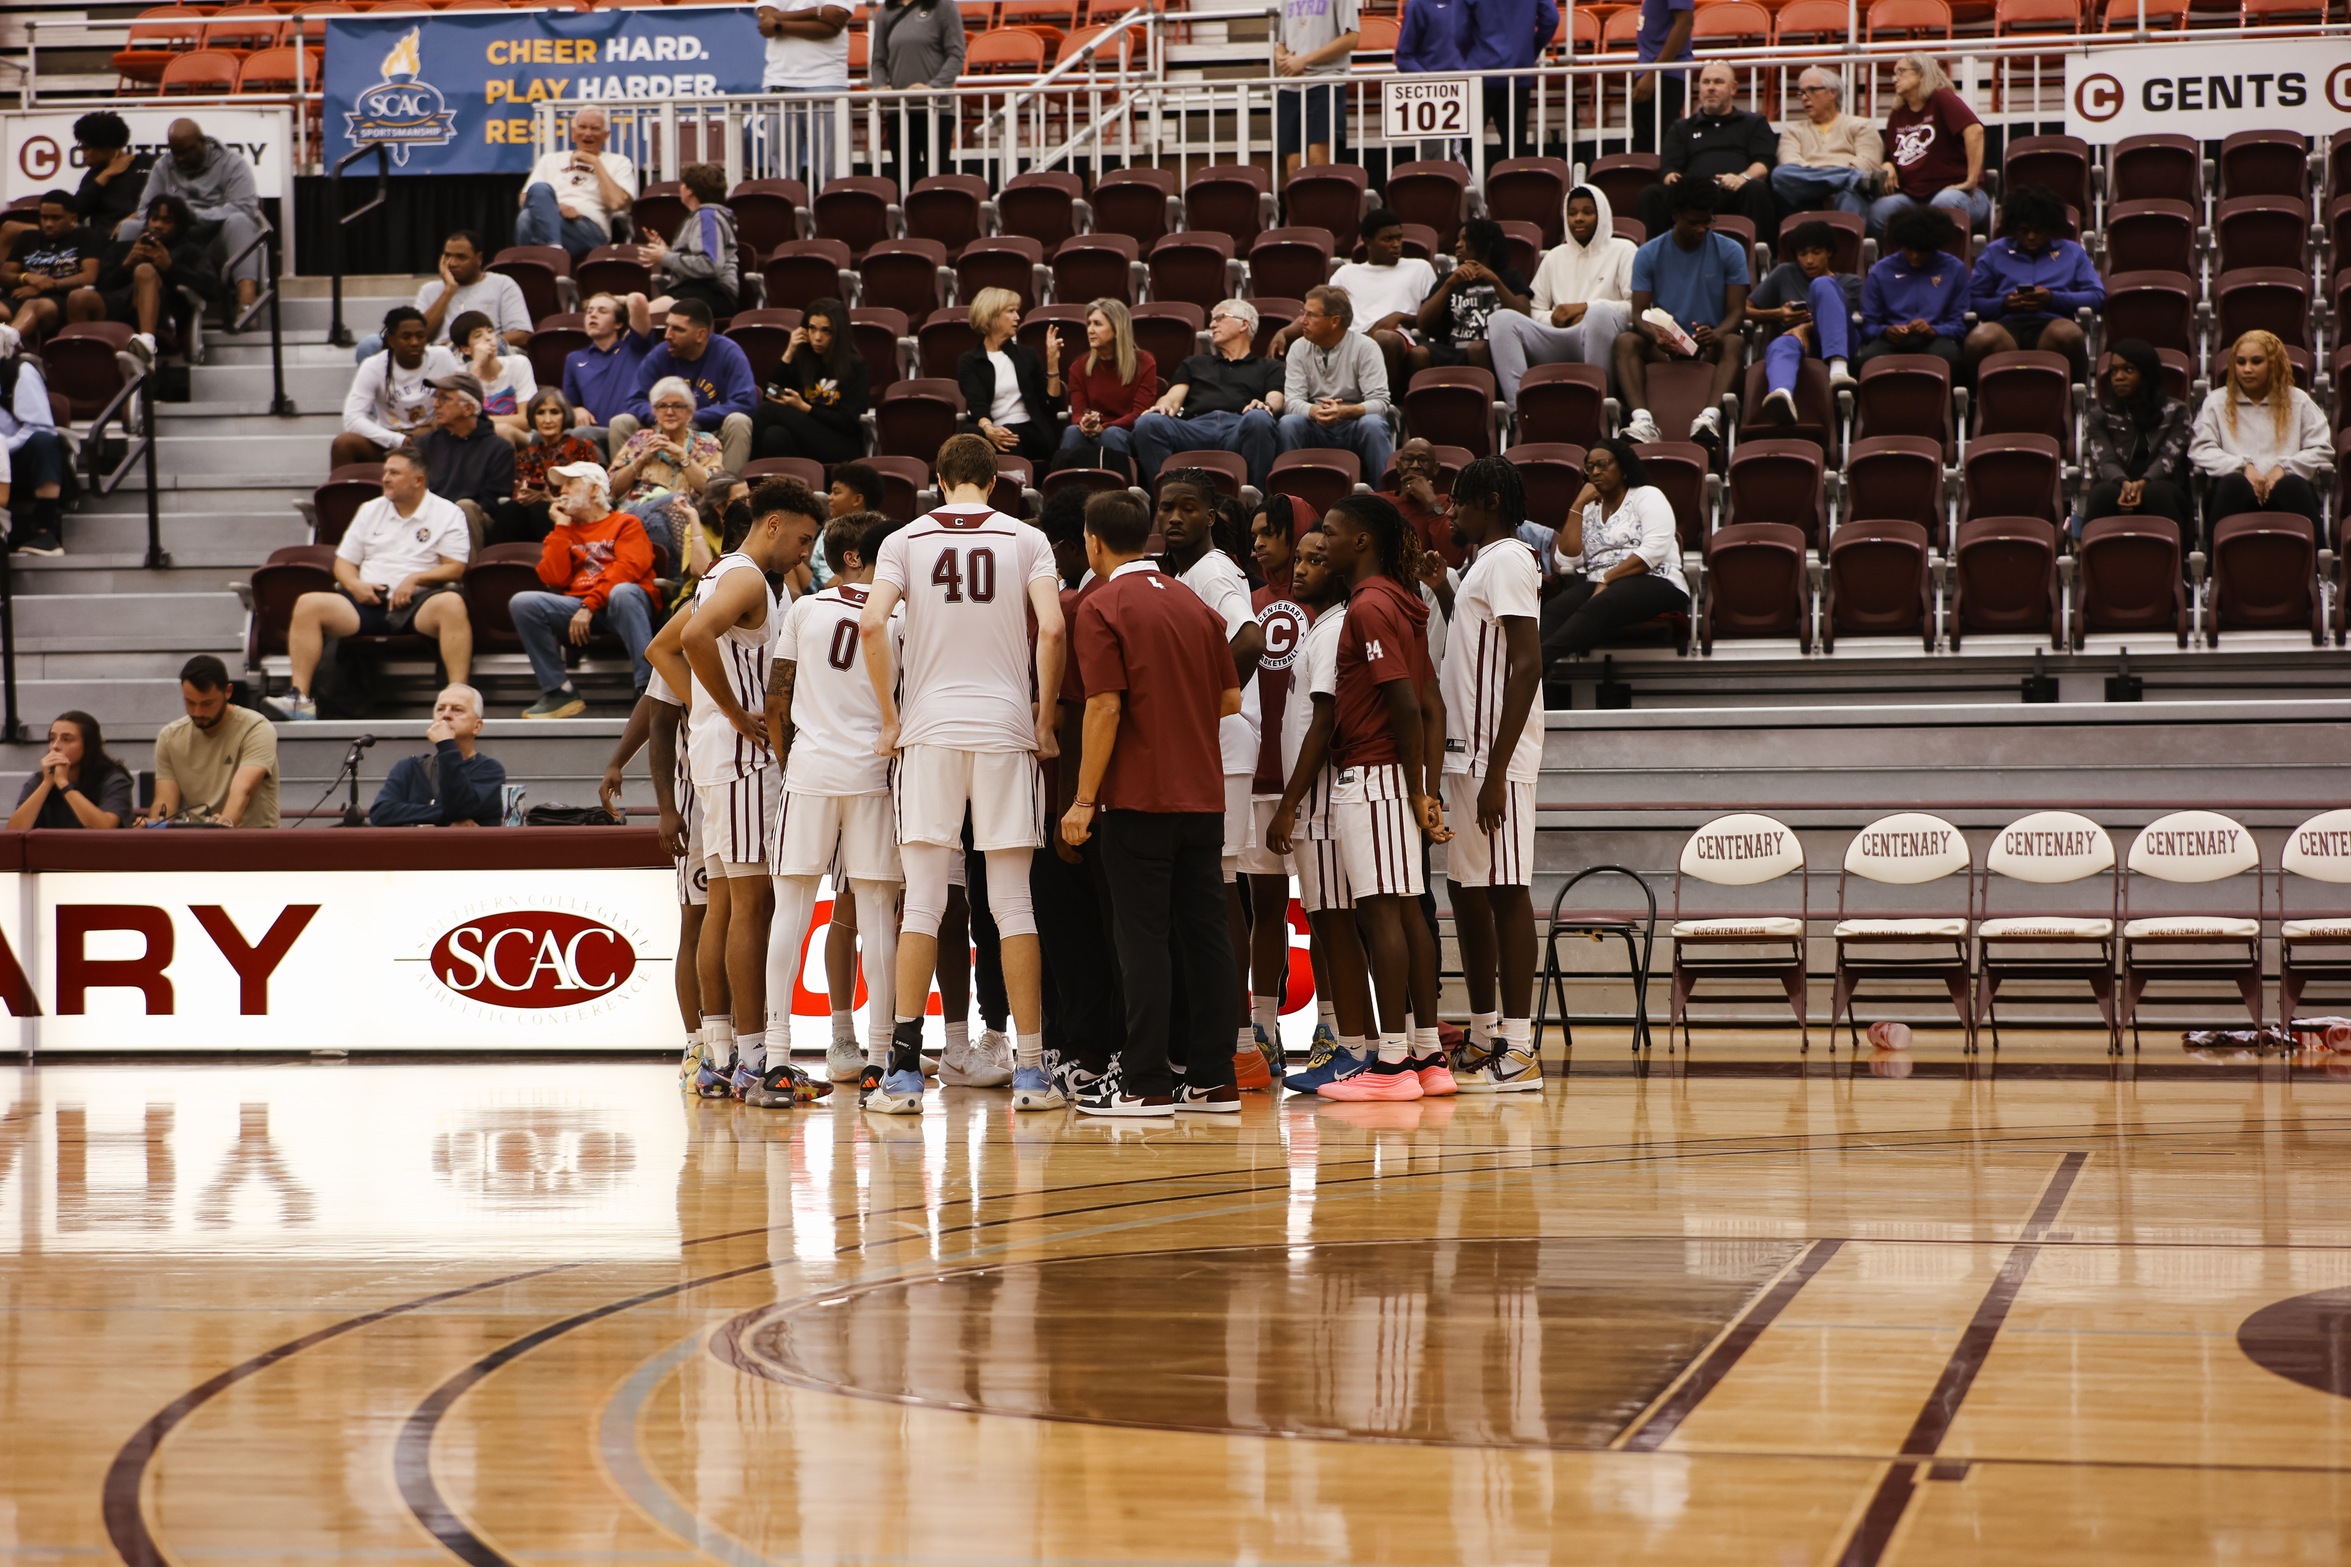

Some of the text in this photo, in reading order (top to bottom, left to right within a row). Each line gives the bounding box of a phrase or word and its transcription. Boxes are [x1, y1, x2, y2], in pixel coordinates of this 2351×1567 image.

[486, 35, 710, 65] CHEER HARD.
[485, 74, 726, 104] PLAY HARDER.
[1395, 84, 1460, 100] SECTION
[2141, 72, 2307, 113] GENTS
[368, 93, 431, 118] SCAC
[1395, 100, 1461, 132] 102
[360, 126, 442, 138] SPORTSMANSHIP
[931, 546, 997, 604] 40
[1258, 603, 1304, 623] CENTENARY
[828, 616, 860, 673] 0
[1261, 649, 1299, 668] ASKETBALL
[1365, 639, 1384, 662] 24
[1696, 831, 1785, 860] CENTENARY
[1862, 830, 1952, 858] CENTENARY
[2005, 830, 2097, 857] CENTENARY
[2145, 829, 2240, 857] CENTENARY
[2300, 831, 2351, 857] CENTE
[417, 894, 652, 952] SOUTHERN COLLEGIATE
[446, 926, 617, 991] SCAC
[416, 970, 652, 1026] ATHLETIC CONFERENCE
